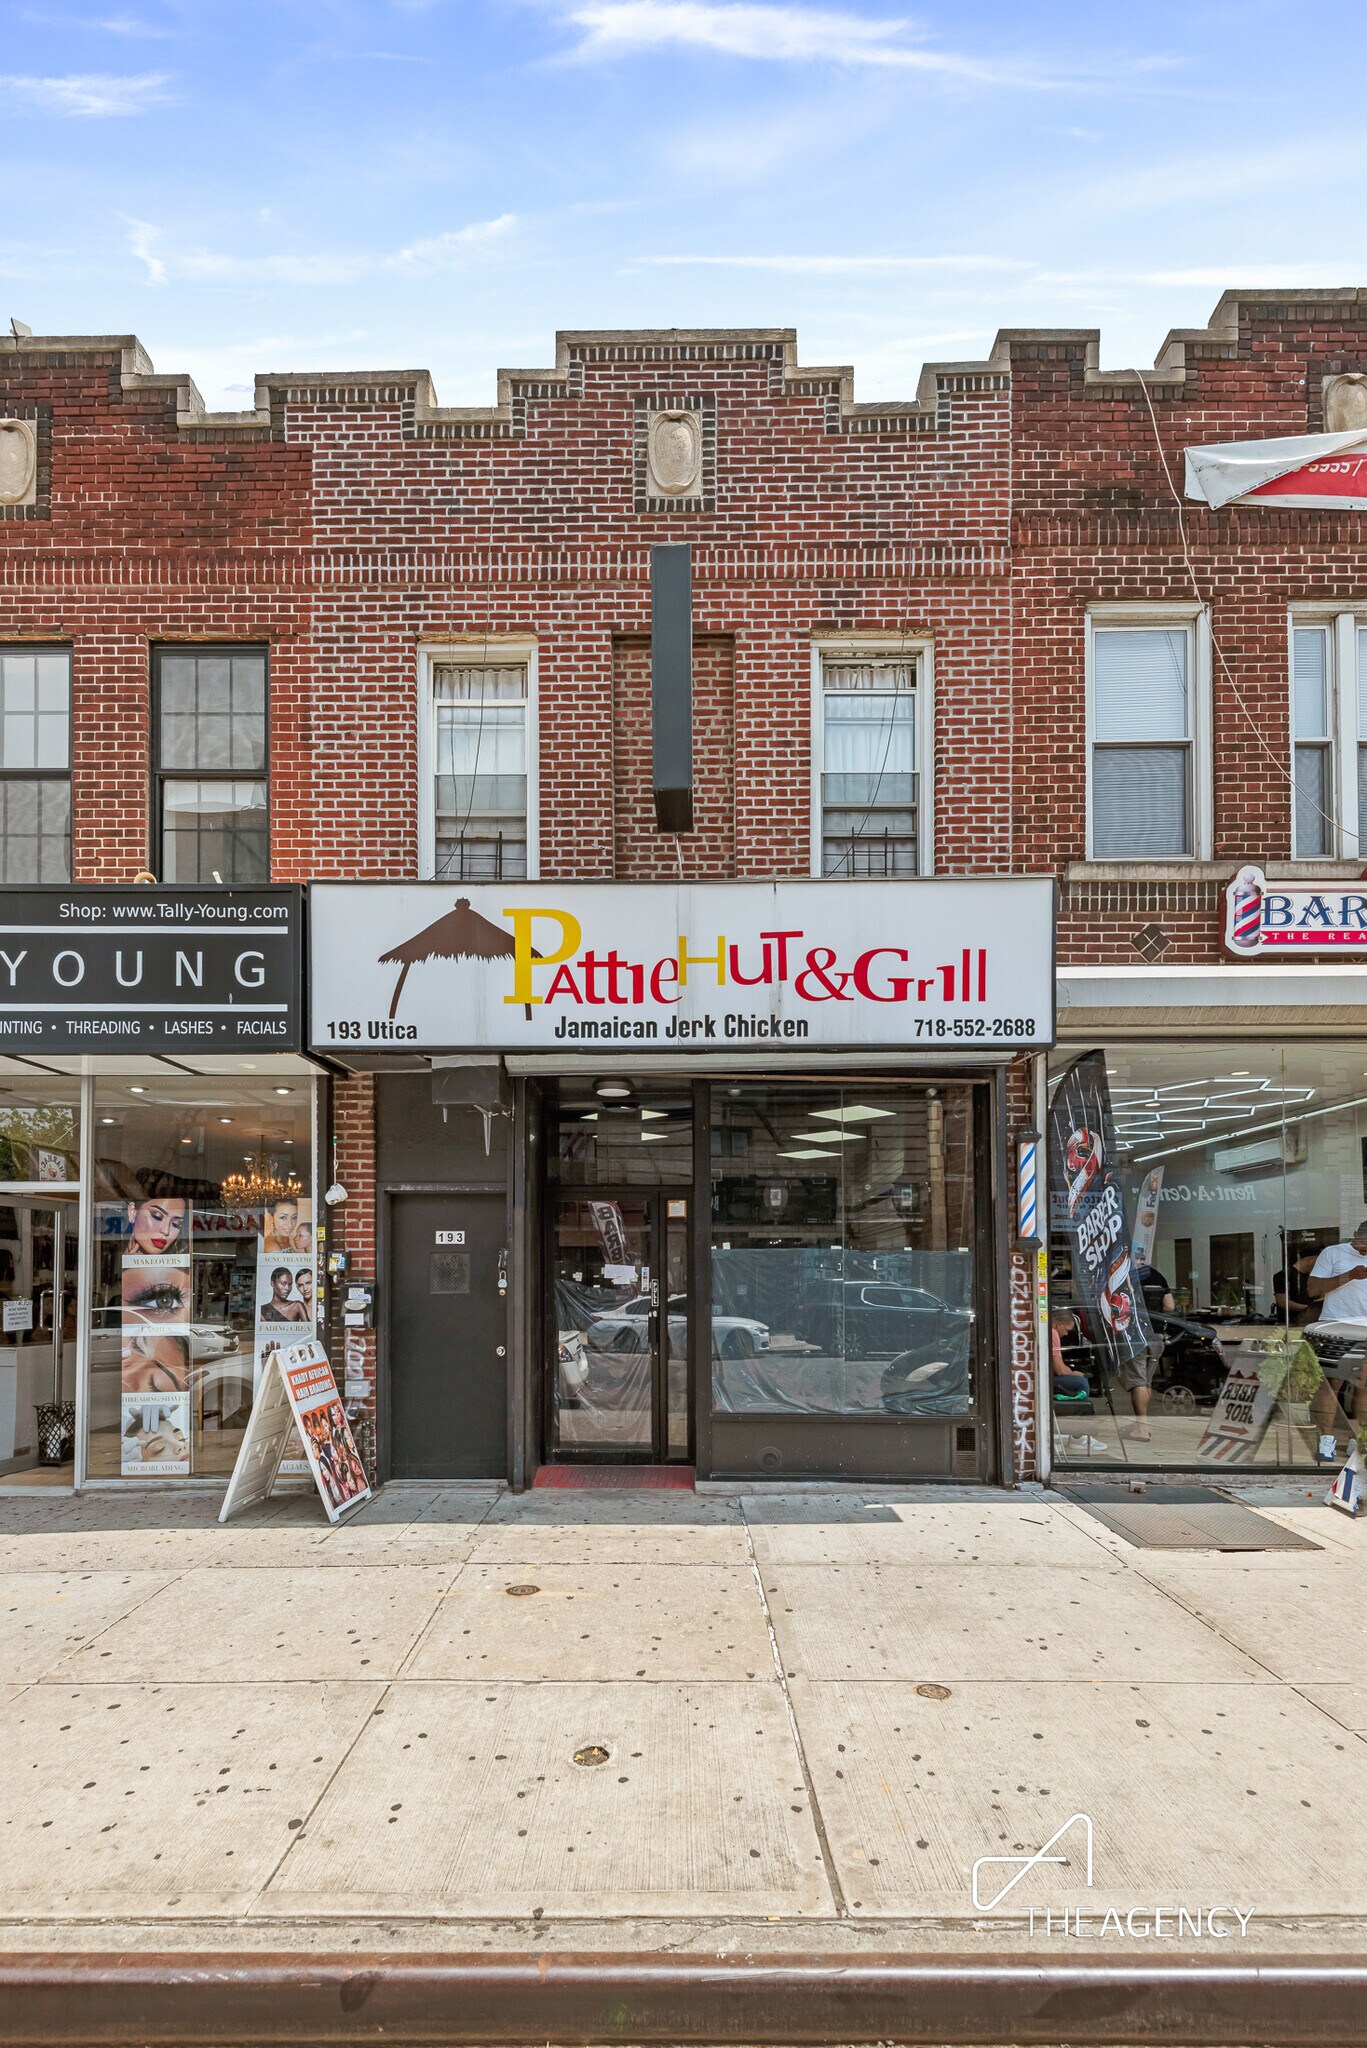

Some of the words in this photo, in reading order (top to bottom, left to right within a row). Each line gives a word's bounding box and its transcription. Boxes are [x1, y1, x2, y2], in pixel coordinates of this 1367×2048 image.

[59, 903, 107, 921] Shop:
[112, 903, 289, 921] www.Tally-Young.com
[1271, 932, 1310, 940] THE
[1328, 932, 1367, 940] REA
[0, 950, 266, 988] YOUNG
[66, 1020, 141, 1035] THREADING
[164, 1020, 214, 1035] LASHES
[236, 1020, 287, 1035] FACIALS
[326, 1021, 361, 1040] 193
[367, 1020, 418, 1041] Utica
[554, 1015, 658, 1039] Jamaican
[665, 1014, 716, 1039] Jerk
[724, 1013, 809, 1038] Chicken
[913, 1018, 1036, 1037] 718-552-2688
[438, 1232, 463, 1243] 193
[1085, 1214, 1123, 1271] SHOP
[127, 1464, 184, 1472] MICROBLADING
